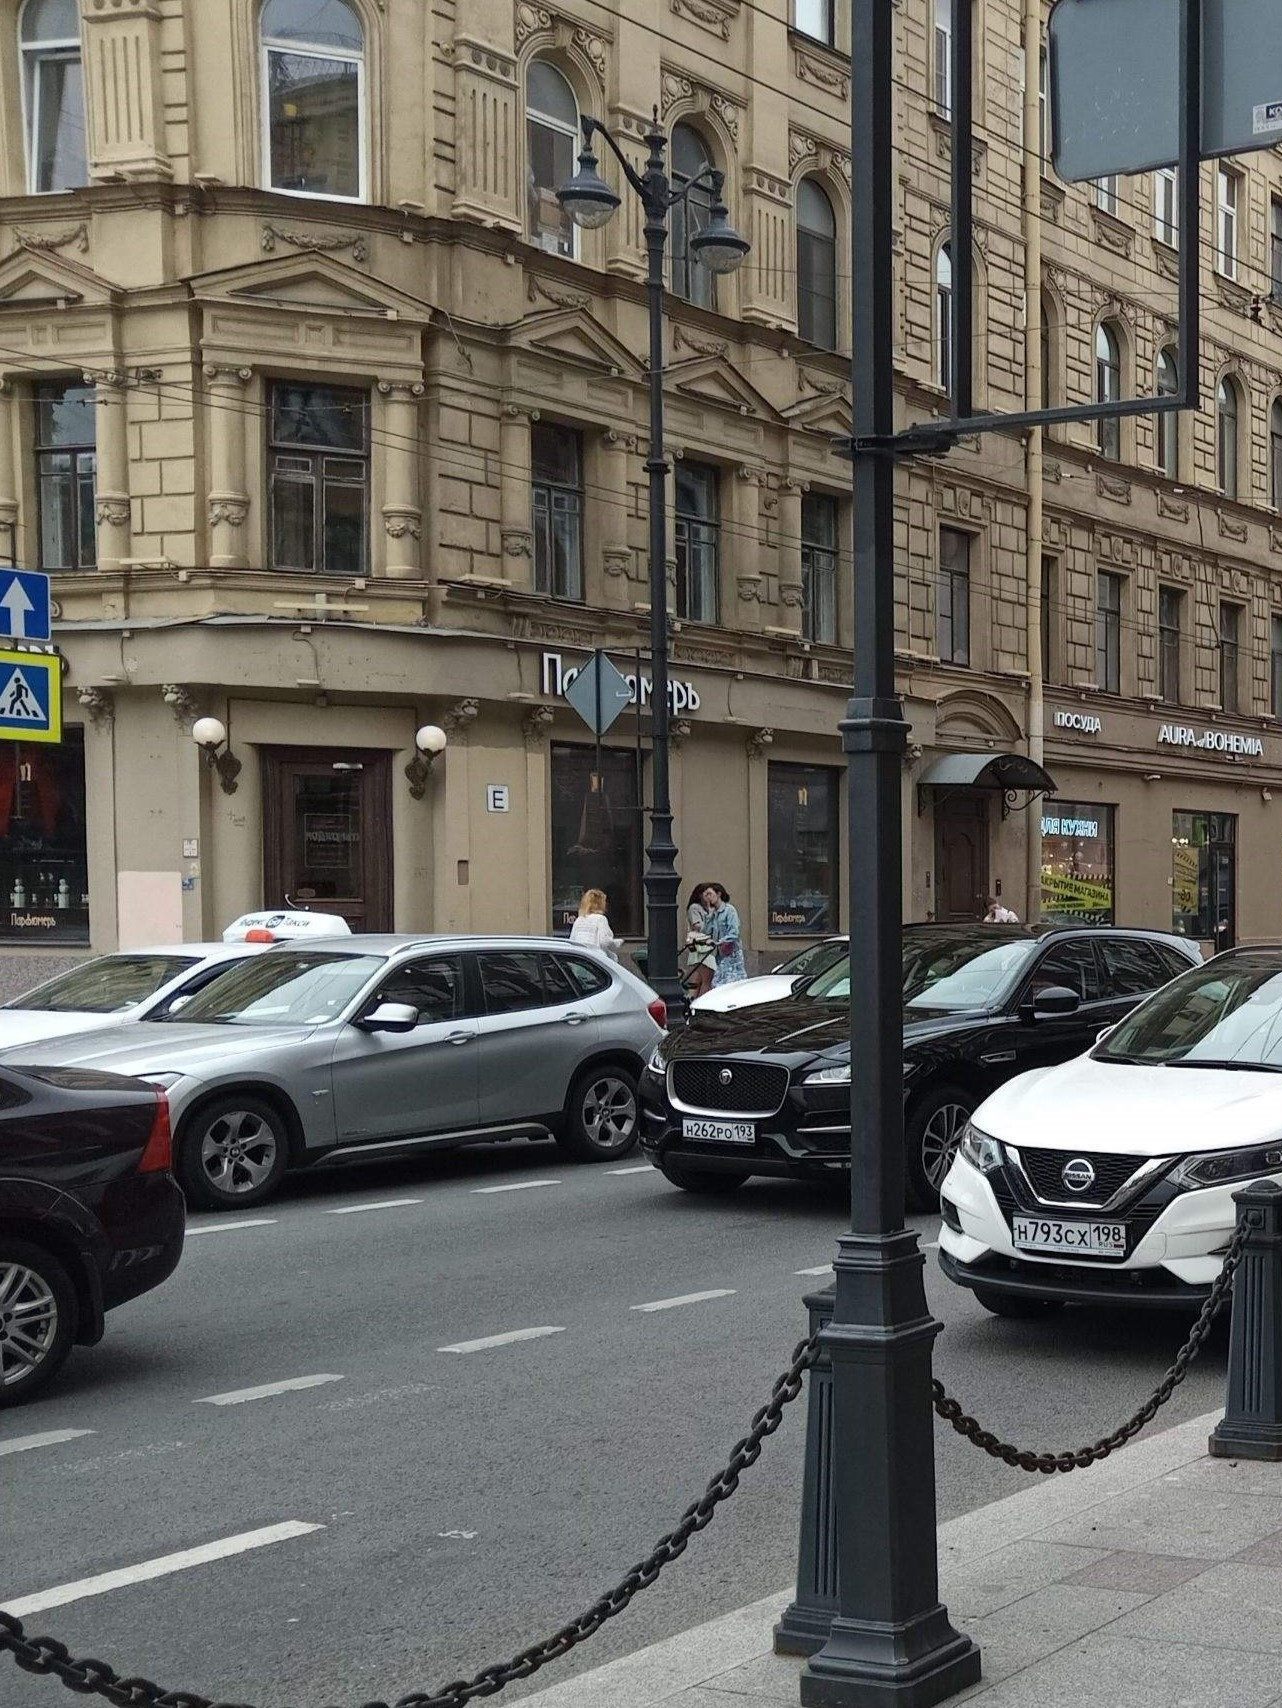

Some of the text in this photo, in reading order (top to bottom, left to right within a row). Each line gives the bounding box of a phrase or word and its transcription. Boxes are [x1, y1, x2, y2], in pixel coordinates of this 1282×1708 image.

[1054, 711, 1102, 734] ПОСУДА
[1157, 724, 1197, 747] AURA
[1203, 731, 1264, 757] BOHEMIA
[734, 1125, 753, 1138] 193
[1018, 1221, 1121, 1246] Н793СХ 198
